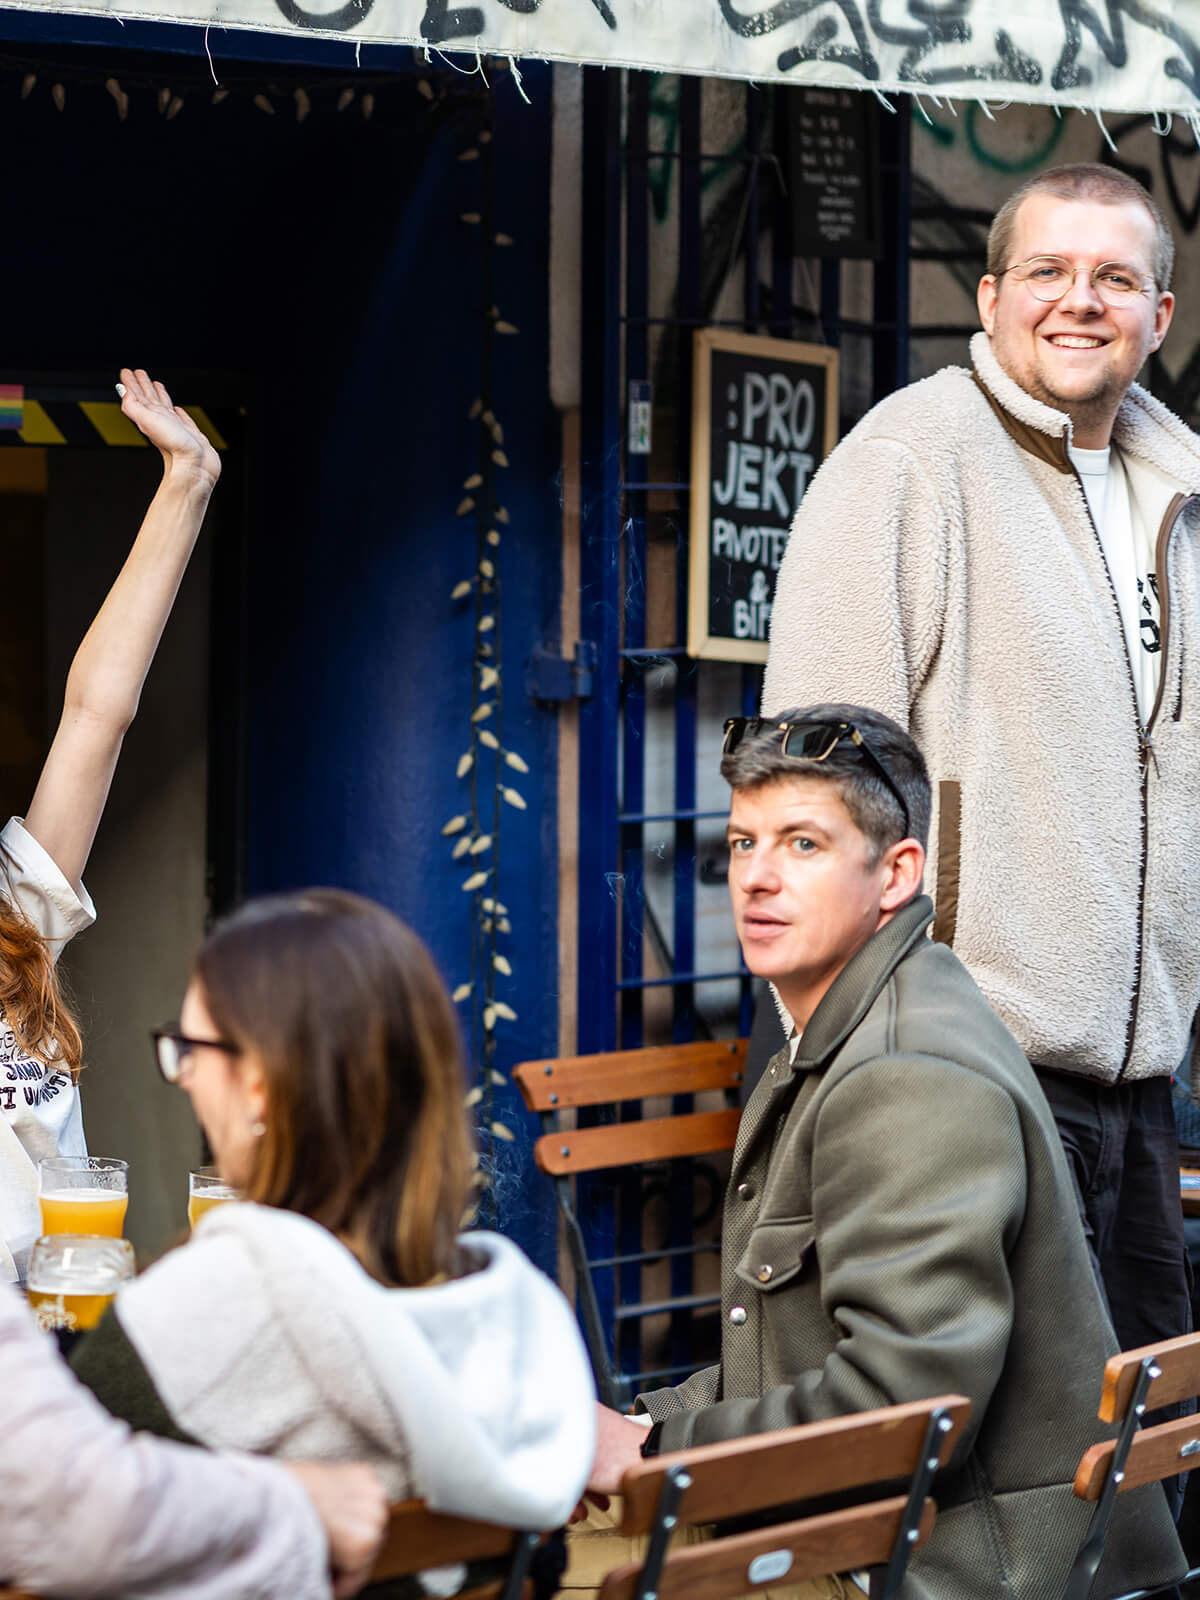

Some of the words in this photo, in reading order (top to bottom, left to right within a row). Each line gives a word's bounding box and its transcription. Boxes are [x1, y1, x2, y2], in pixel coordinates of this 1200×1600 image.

[728, 371, 815, 449] :PRO
[714, 440, 814, 519] JEKT
[750, 570, 769, 602] &
